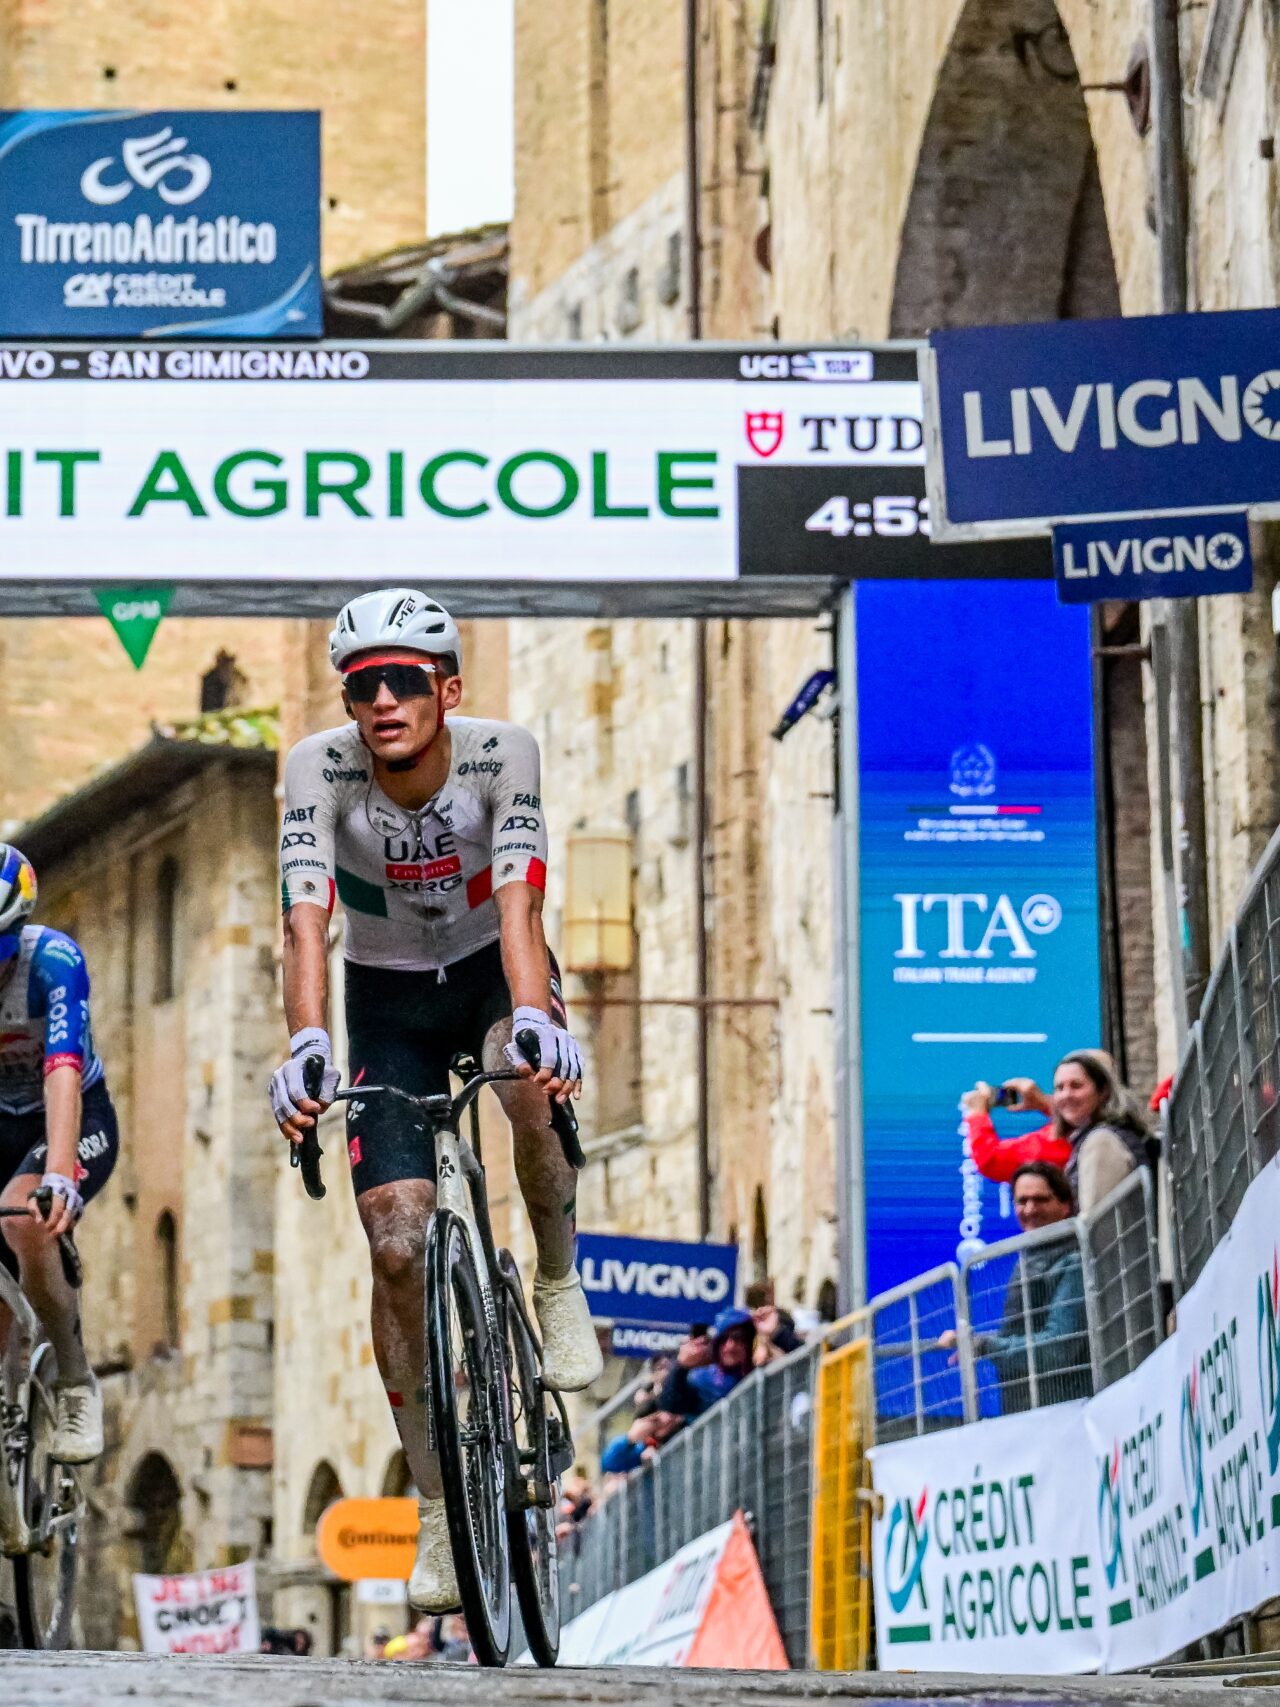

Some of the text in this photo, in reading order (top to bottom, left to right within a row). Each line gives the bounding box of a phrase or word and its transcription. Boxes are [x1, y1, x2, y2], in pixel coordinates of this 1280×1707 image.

[14, 213, 277, 264] TirrenoAdriatico
[87, 350, 160, 379] SAN
[165, 350, 370, 379] GIMIGNANO
[739, 354, 790, 379] UCI
[125, 450, 720, 519] AGRICOLE
[1062, 532, 1244, 580] LIVIGNO
[396, 595, 417, 629] MET
[384, 831, 457, 862] UAE
[892, 893, 1038, 959] ITA
[48, 985, 69, 1045] BOSS
[580, 1256, 730, 1304] LIVIGNO
[932, 1464, 1035, 1557] CRÉDIT
[940, 1555, 1093, 1642] AGRICOLE
